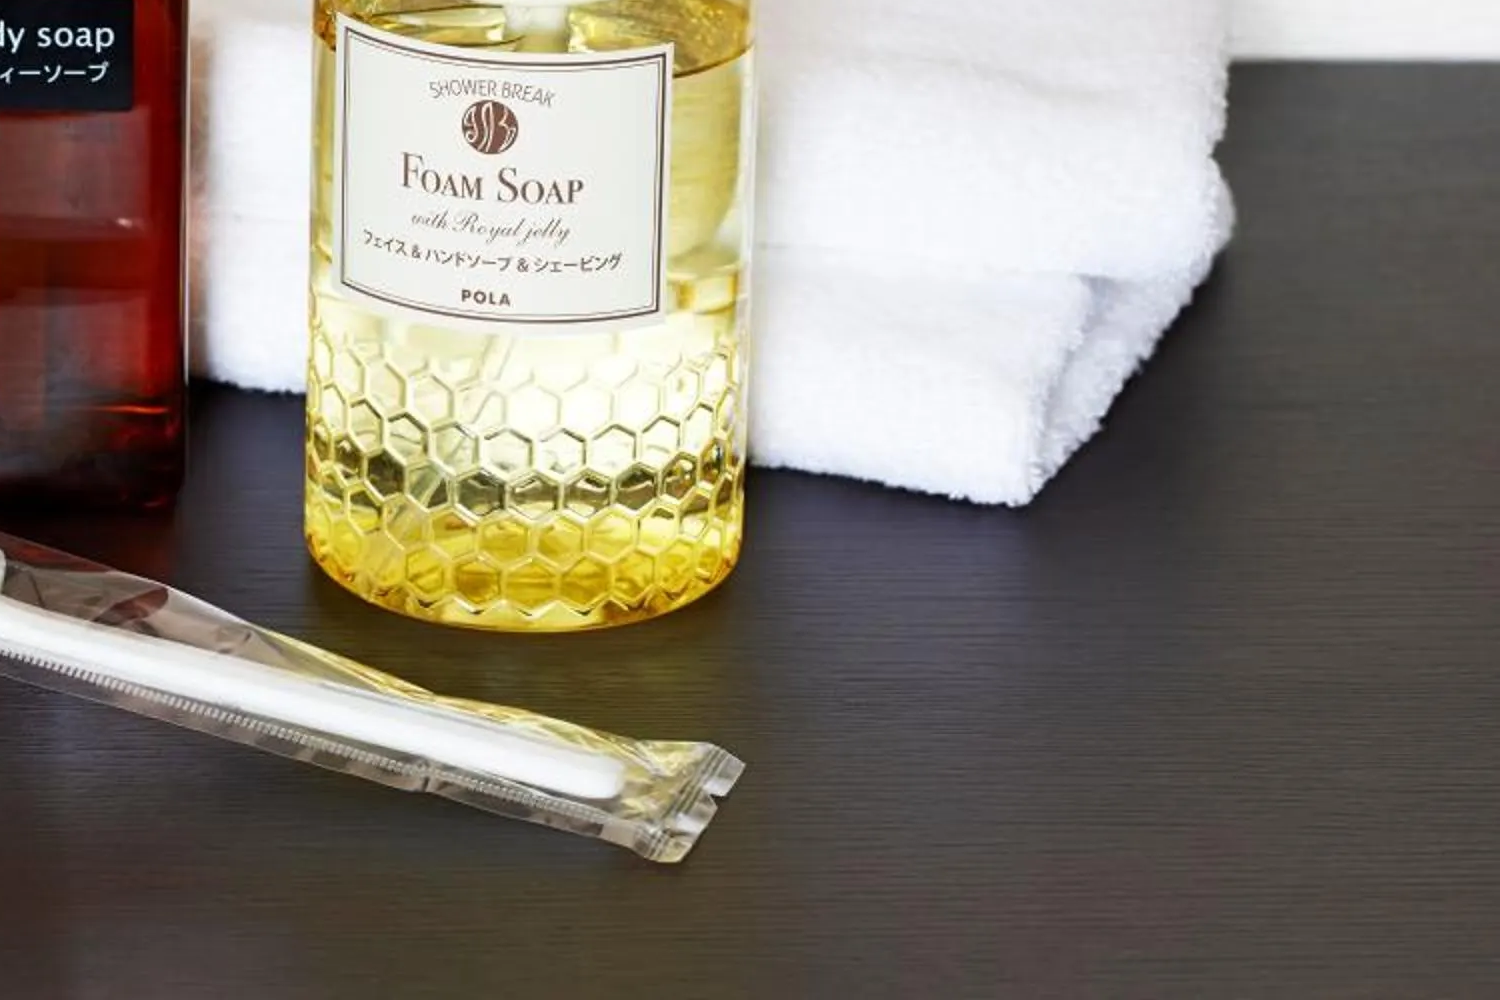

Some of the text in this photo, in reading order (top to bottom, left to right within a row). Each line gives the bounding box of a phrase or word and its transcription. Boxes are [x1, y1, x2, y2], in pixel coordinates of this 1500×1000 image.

[37, 26, 115, 53] soap
[429, 79, 556, 107] SHOWER BREAK
[401, 151, 584, 205] FOAM SOAP
[411, 209, 570, 249] with Royal jelly
[461, 289, 511, 306] POLA
